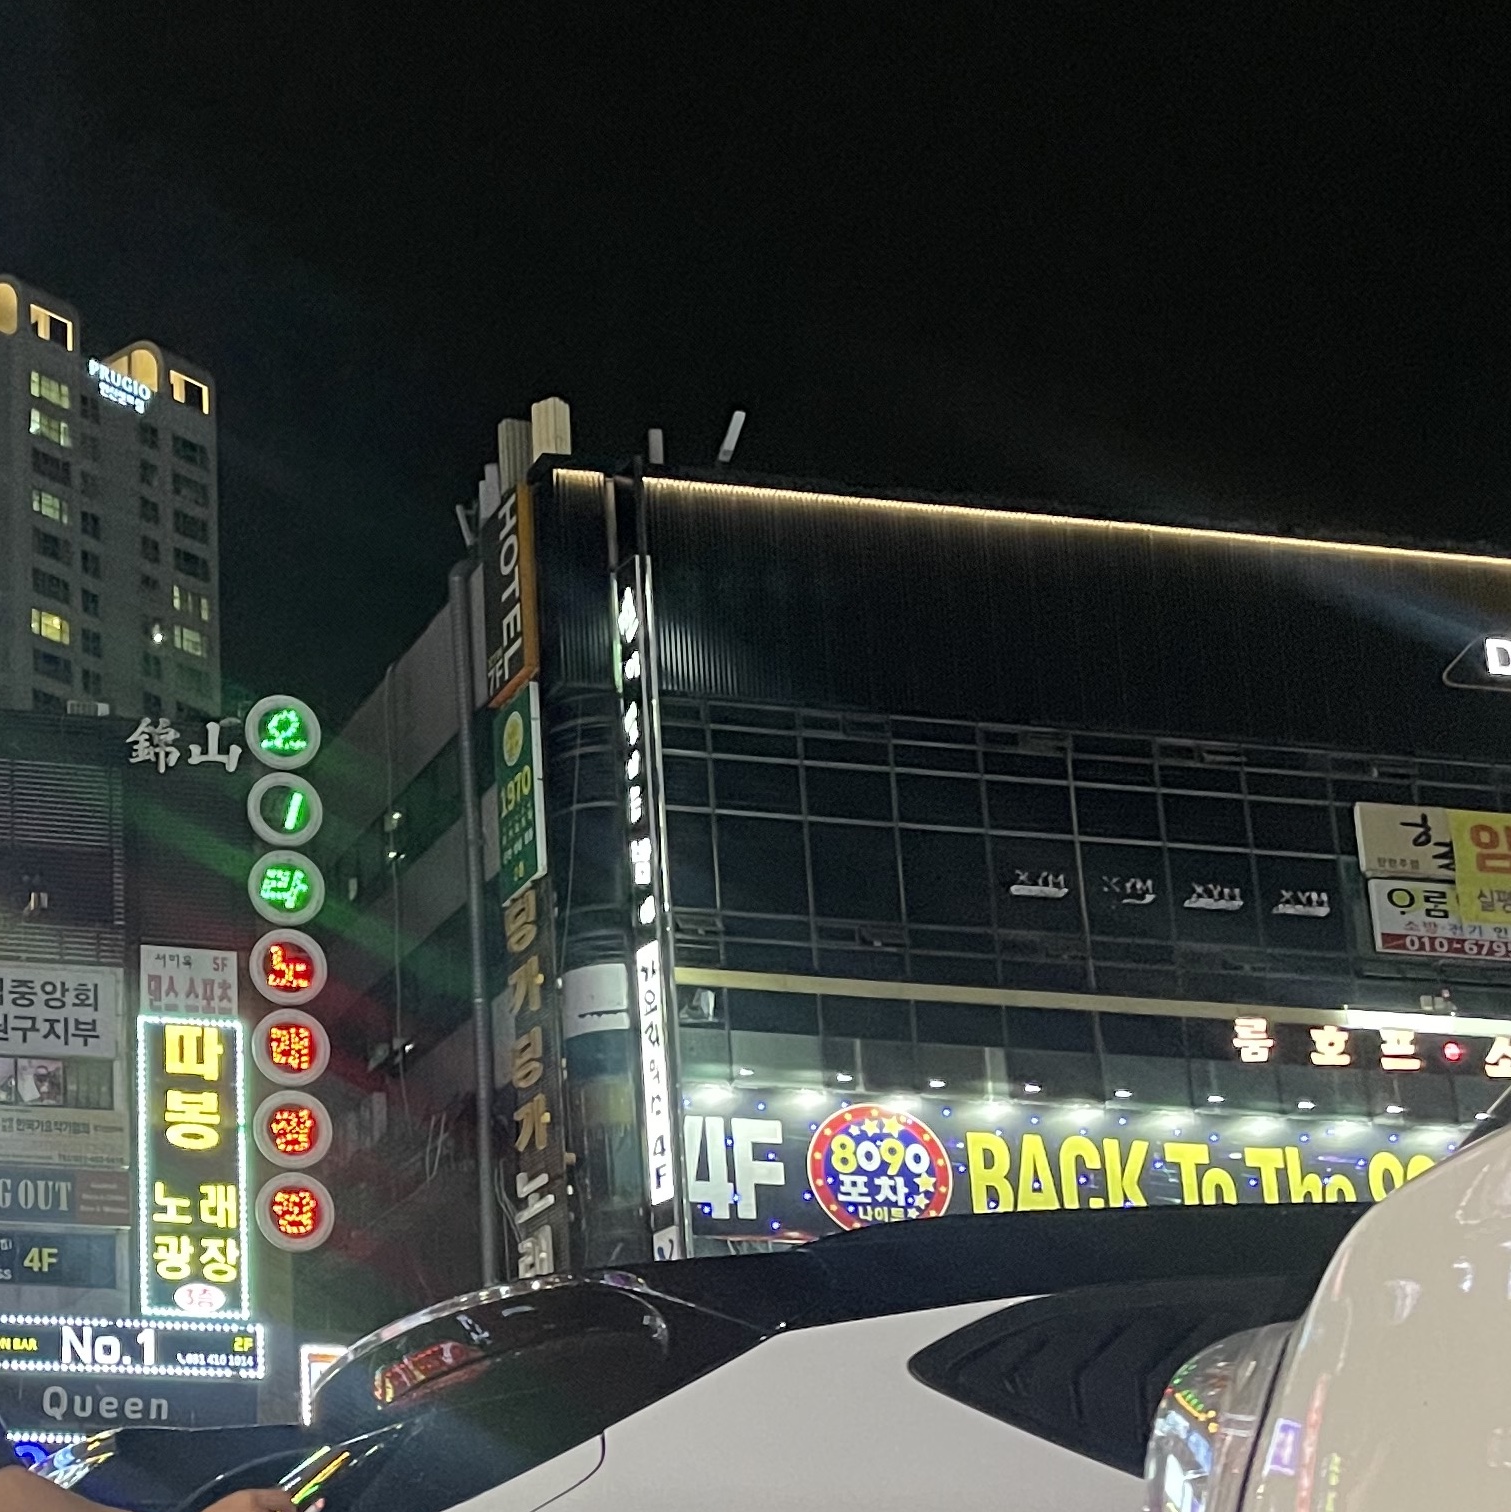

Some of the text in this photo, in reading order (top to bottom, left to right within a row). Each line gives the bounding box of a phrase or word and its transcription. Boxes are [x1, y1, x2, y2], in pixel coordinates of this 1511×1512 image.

[497, 492, 523, 683] HOTEL
[126, 717, 244, 774] 錦山
[500, 764, 532, 820] 1970
[212, 956, 229, 973] 5F
[683, 1115, 786, 1220] 4F
[830, 1133, 932, 1176] 8090
[965, 1131, 1151, 1214] BACK
[17, 1178, 73, 1213] OUT
[837, 1172, 911, 1207] 포차
[22, 1246, 60, 1274] 4F
[59, 1324, 158, 1368] No.1
[41, 1385, 170, 1422] Queen
